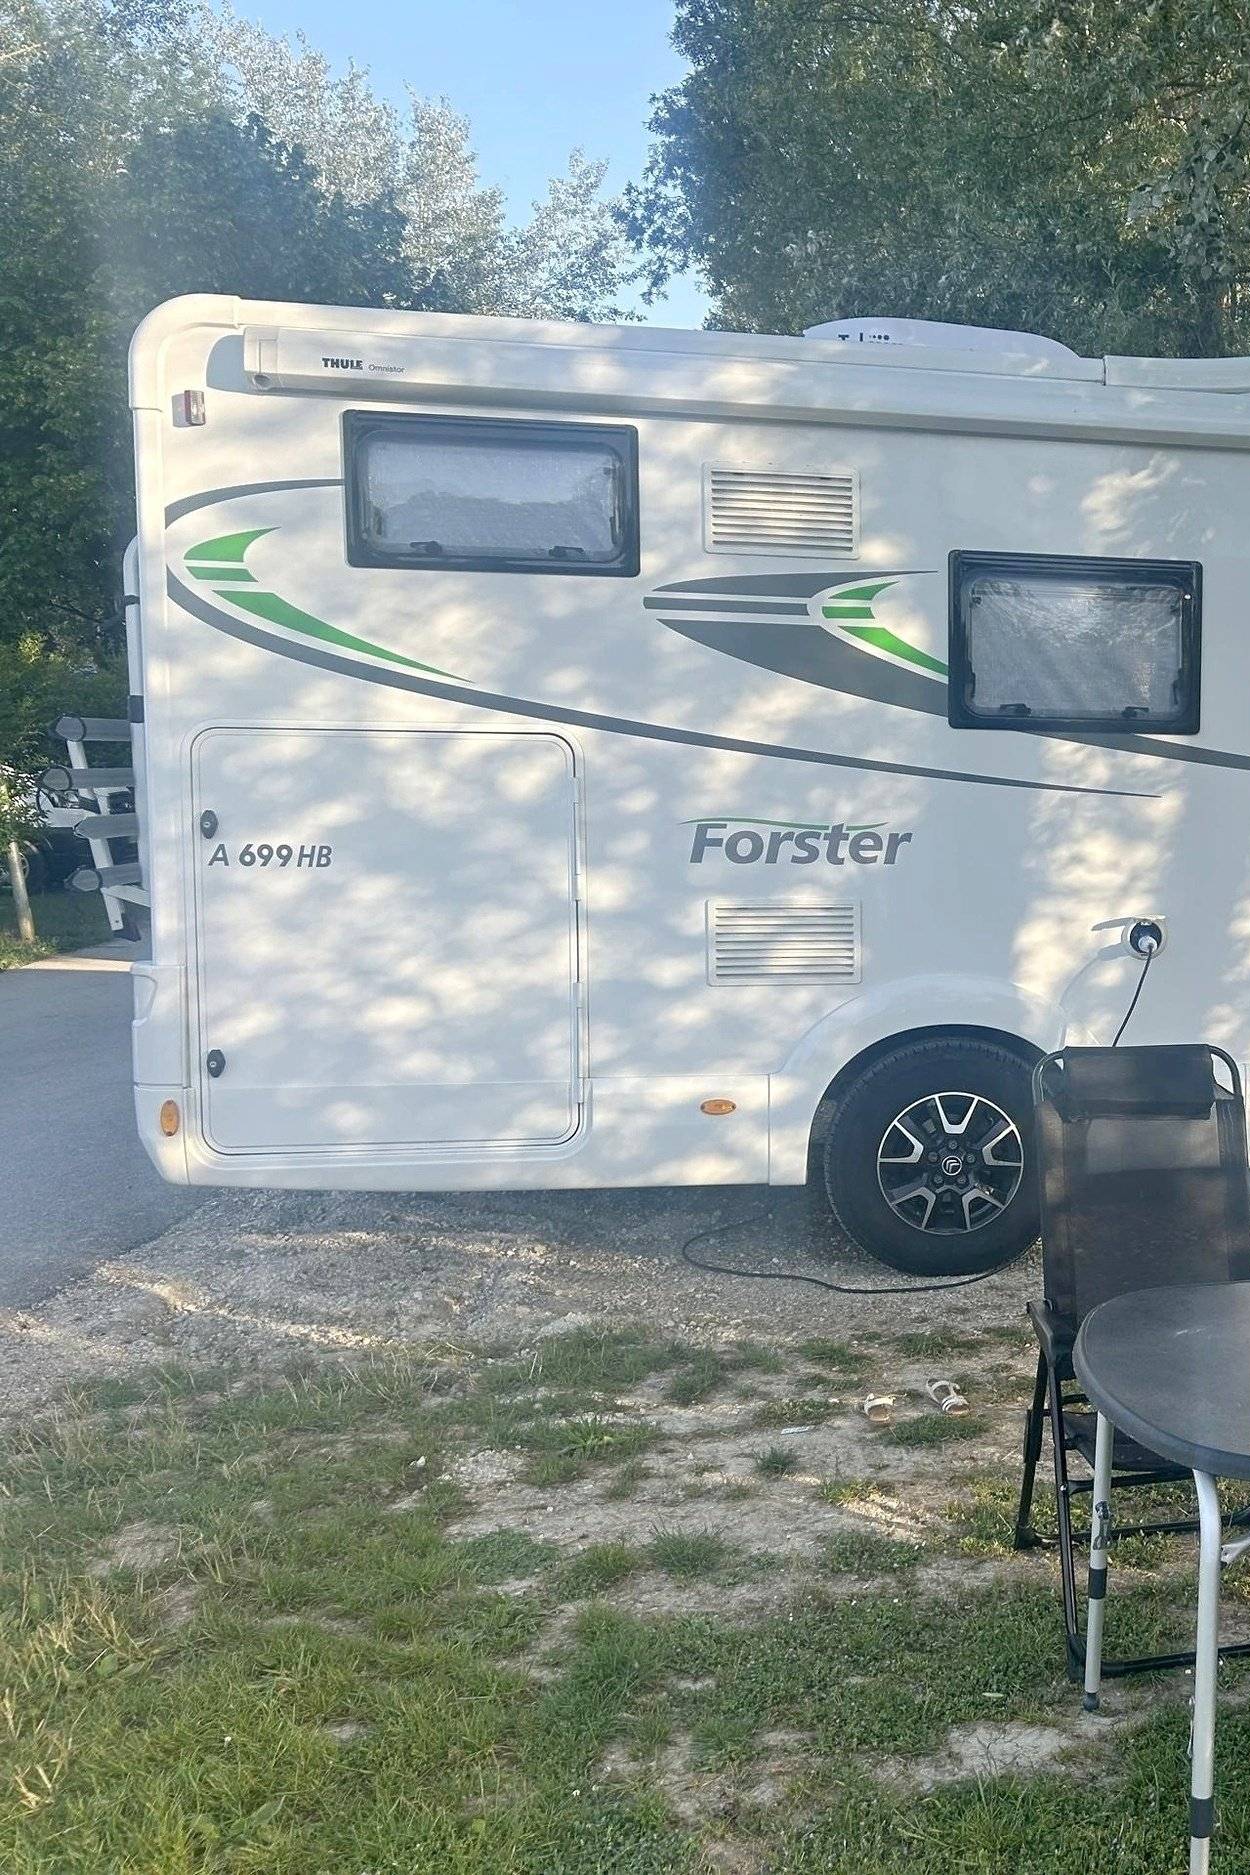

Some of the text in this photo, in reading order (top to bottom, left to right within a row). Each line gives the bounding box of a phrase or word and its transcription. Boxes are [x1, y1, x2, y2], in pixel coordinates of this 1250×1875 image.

[322, 358, 363, 370] THULE
[690, 822, 913, 865] Forster
[208, 844, 229, 866] A
